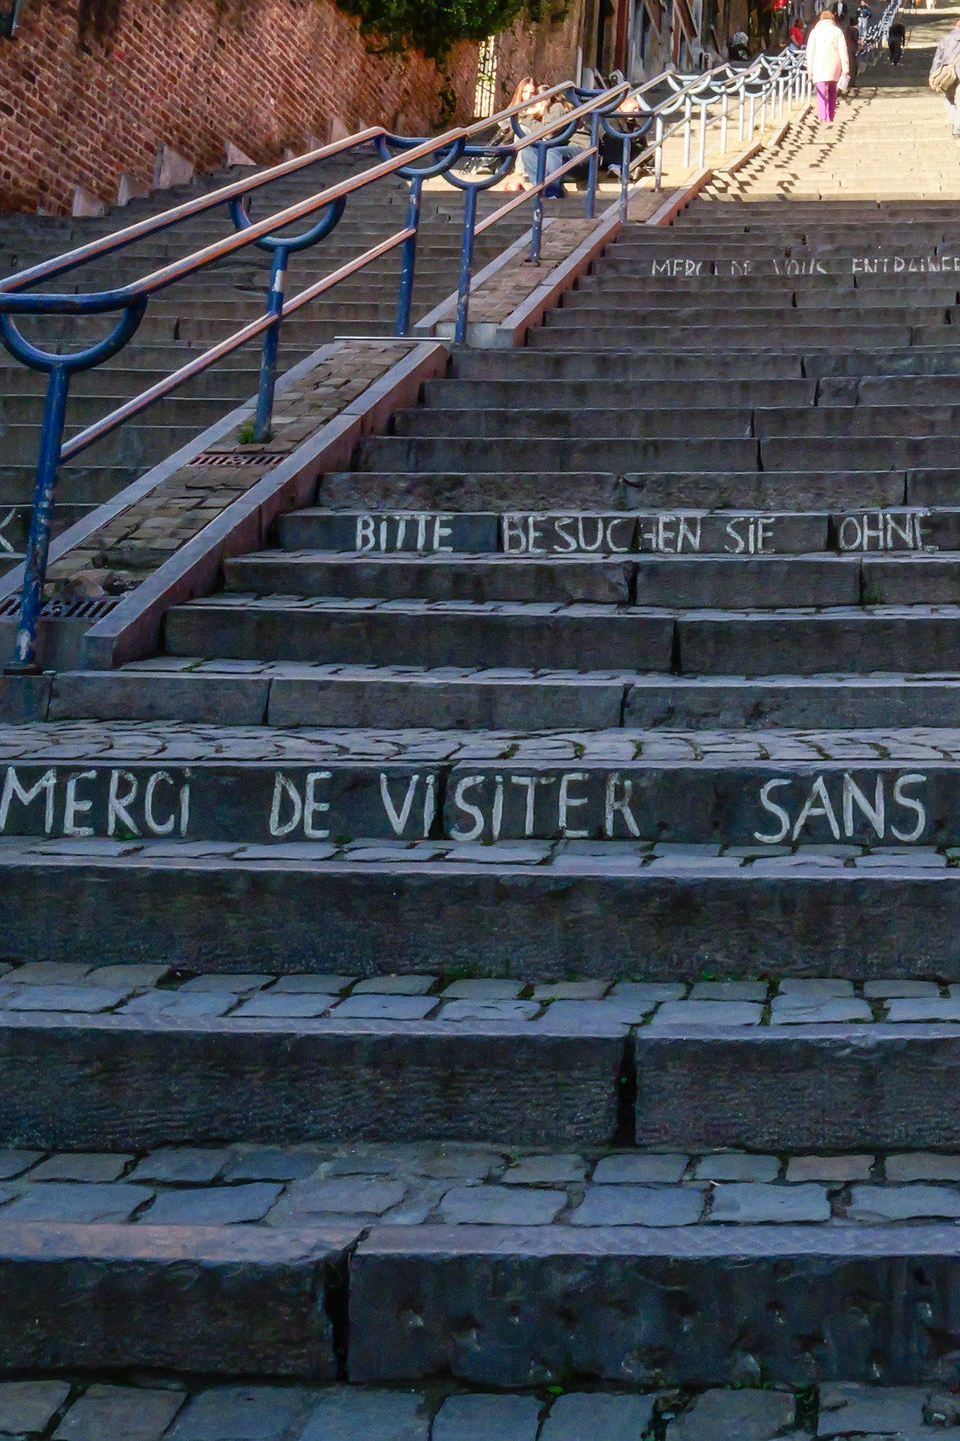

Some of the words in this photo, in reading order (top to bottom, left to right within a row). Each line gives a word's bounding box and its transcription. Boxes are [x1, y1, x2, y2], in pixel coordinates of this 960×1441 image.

[502, 515, 702, 554] BESUCHEN
[839, 512, 940, 553] OHNE
[269, 770, 334, 839] DE
[753, 772, 929, 843] SANS
